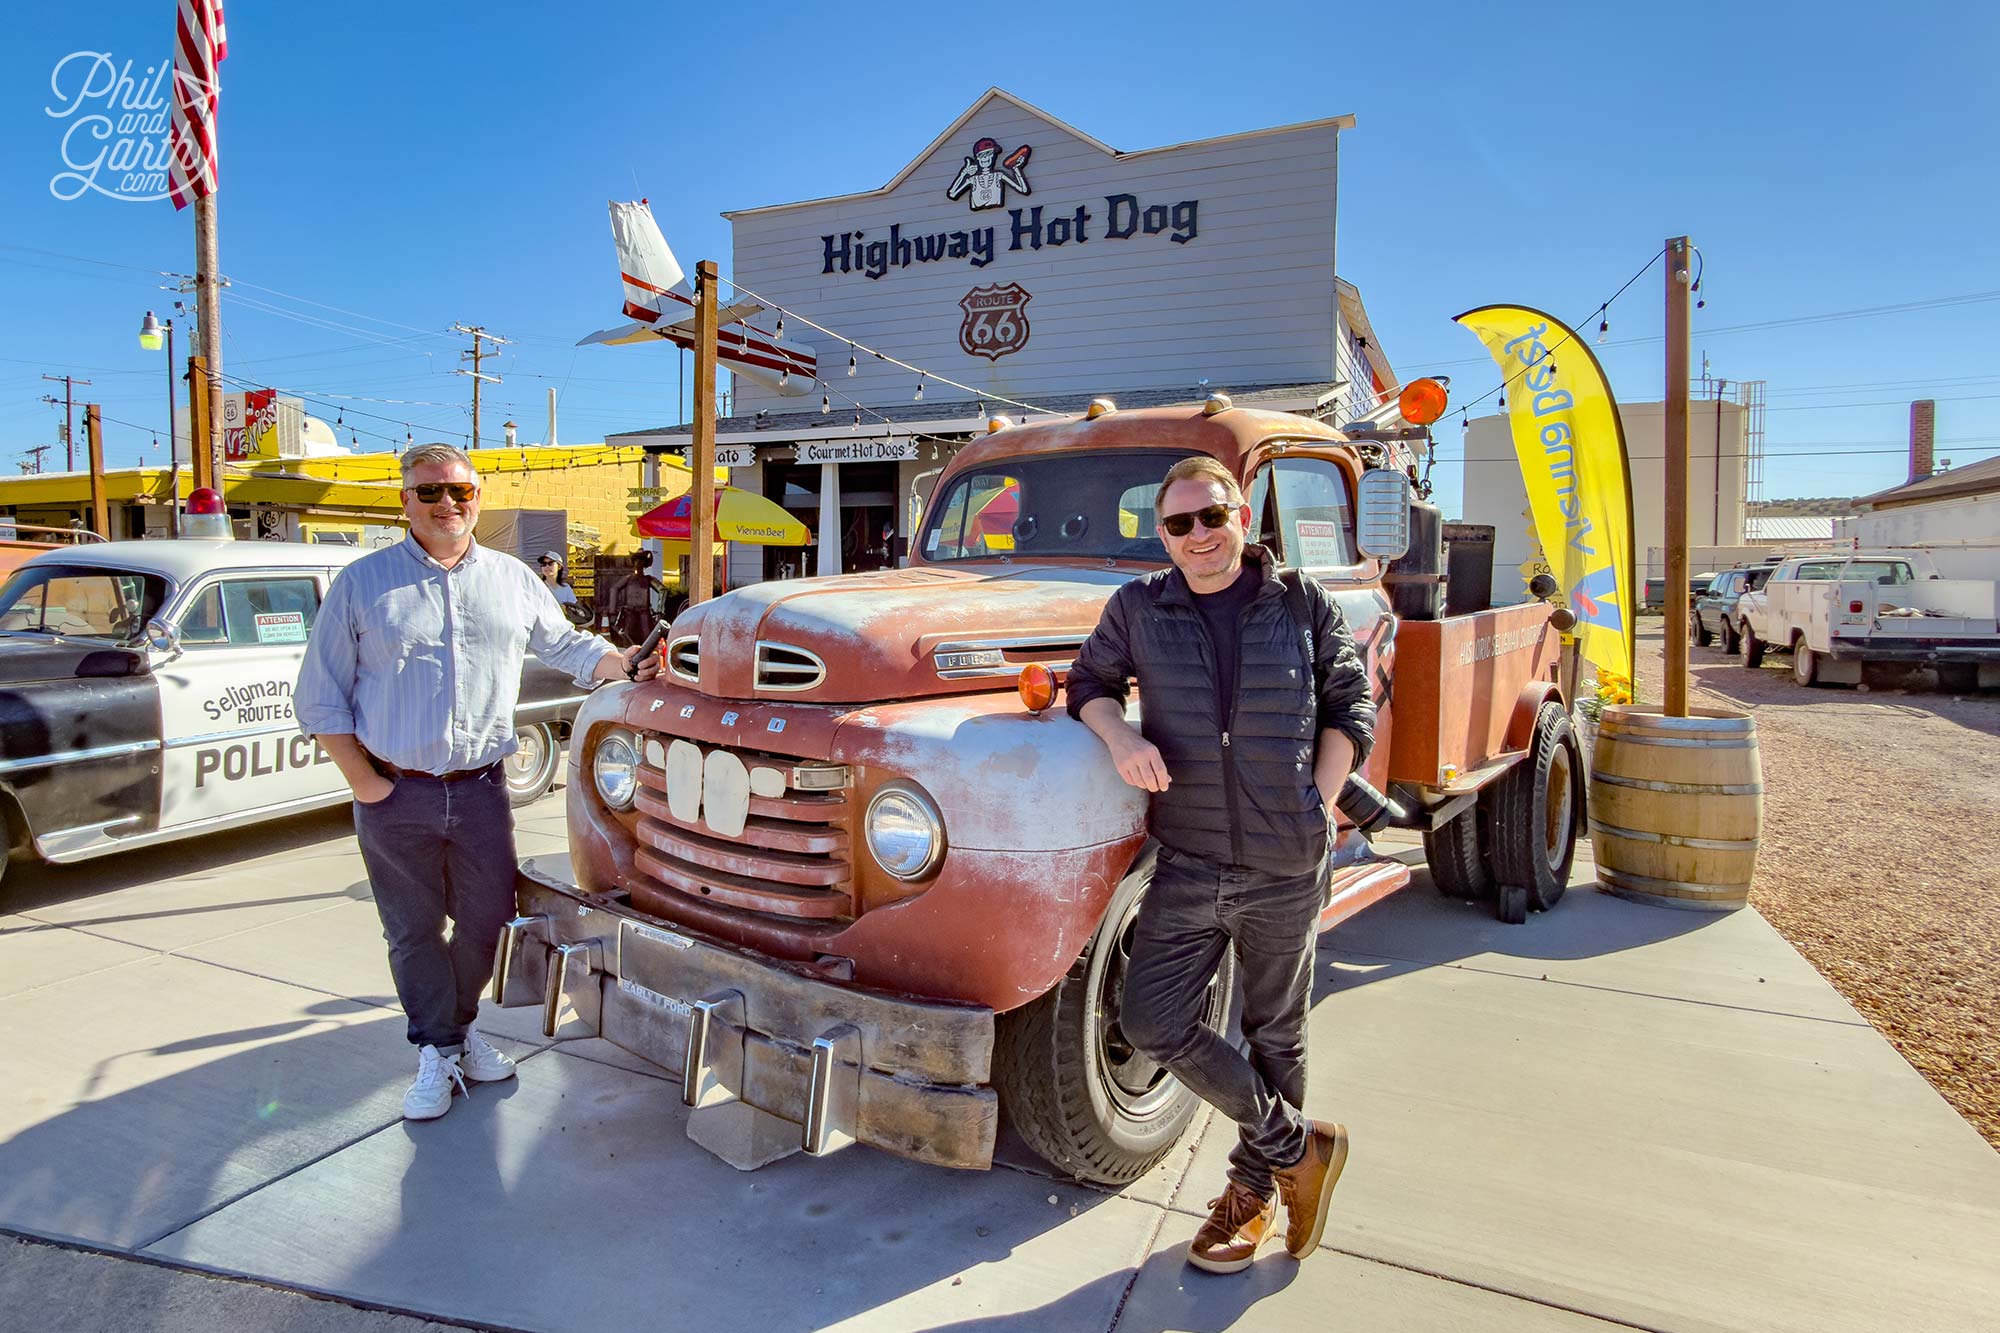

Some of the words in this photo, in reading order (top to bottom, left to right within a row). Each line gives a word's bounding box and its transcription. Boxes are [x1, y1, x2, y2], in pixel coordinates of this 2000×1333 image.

[821, 223, 994, 280] Highway
[1008, 205, 1092, 251] Hot
[1104, 193, 1199, 244] Dog
[976, 294, 1014, 307] ROUTE
[972, 311, 1017, 345] 66
[808, 444, 851, 460] Gourmet
[851, 443, 874, 459] Hot
[874, 442, 905, 460] Dogs
[736, 524, 766, 536] Vienna
[766, 527, 785, 539] Beef
[261, 615, 299, 624] ATTENTION
[1304, 629, 1315, 663] Canon
[238, 704, 282, 724] ROUTE
[623, 980, 654, 1001] EARLY
[664, 998, 692, 1018] FORD
